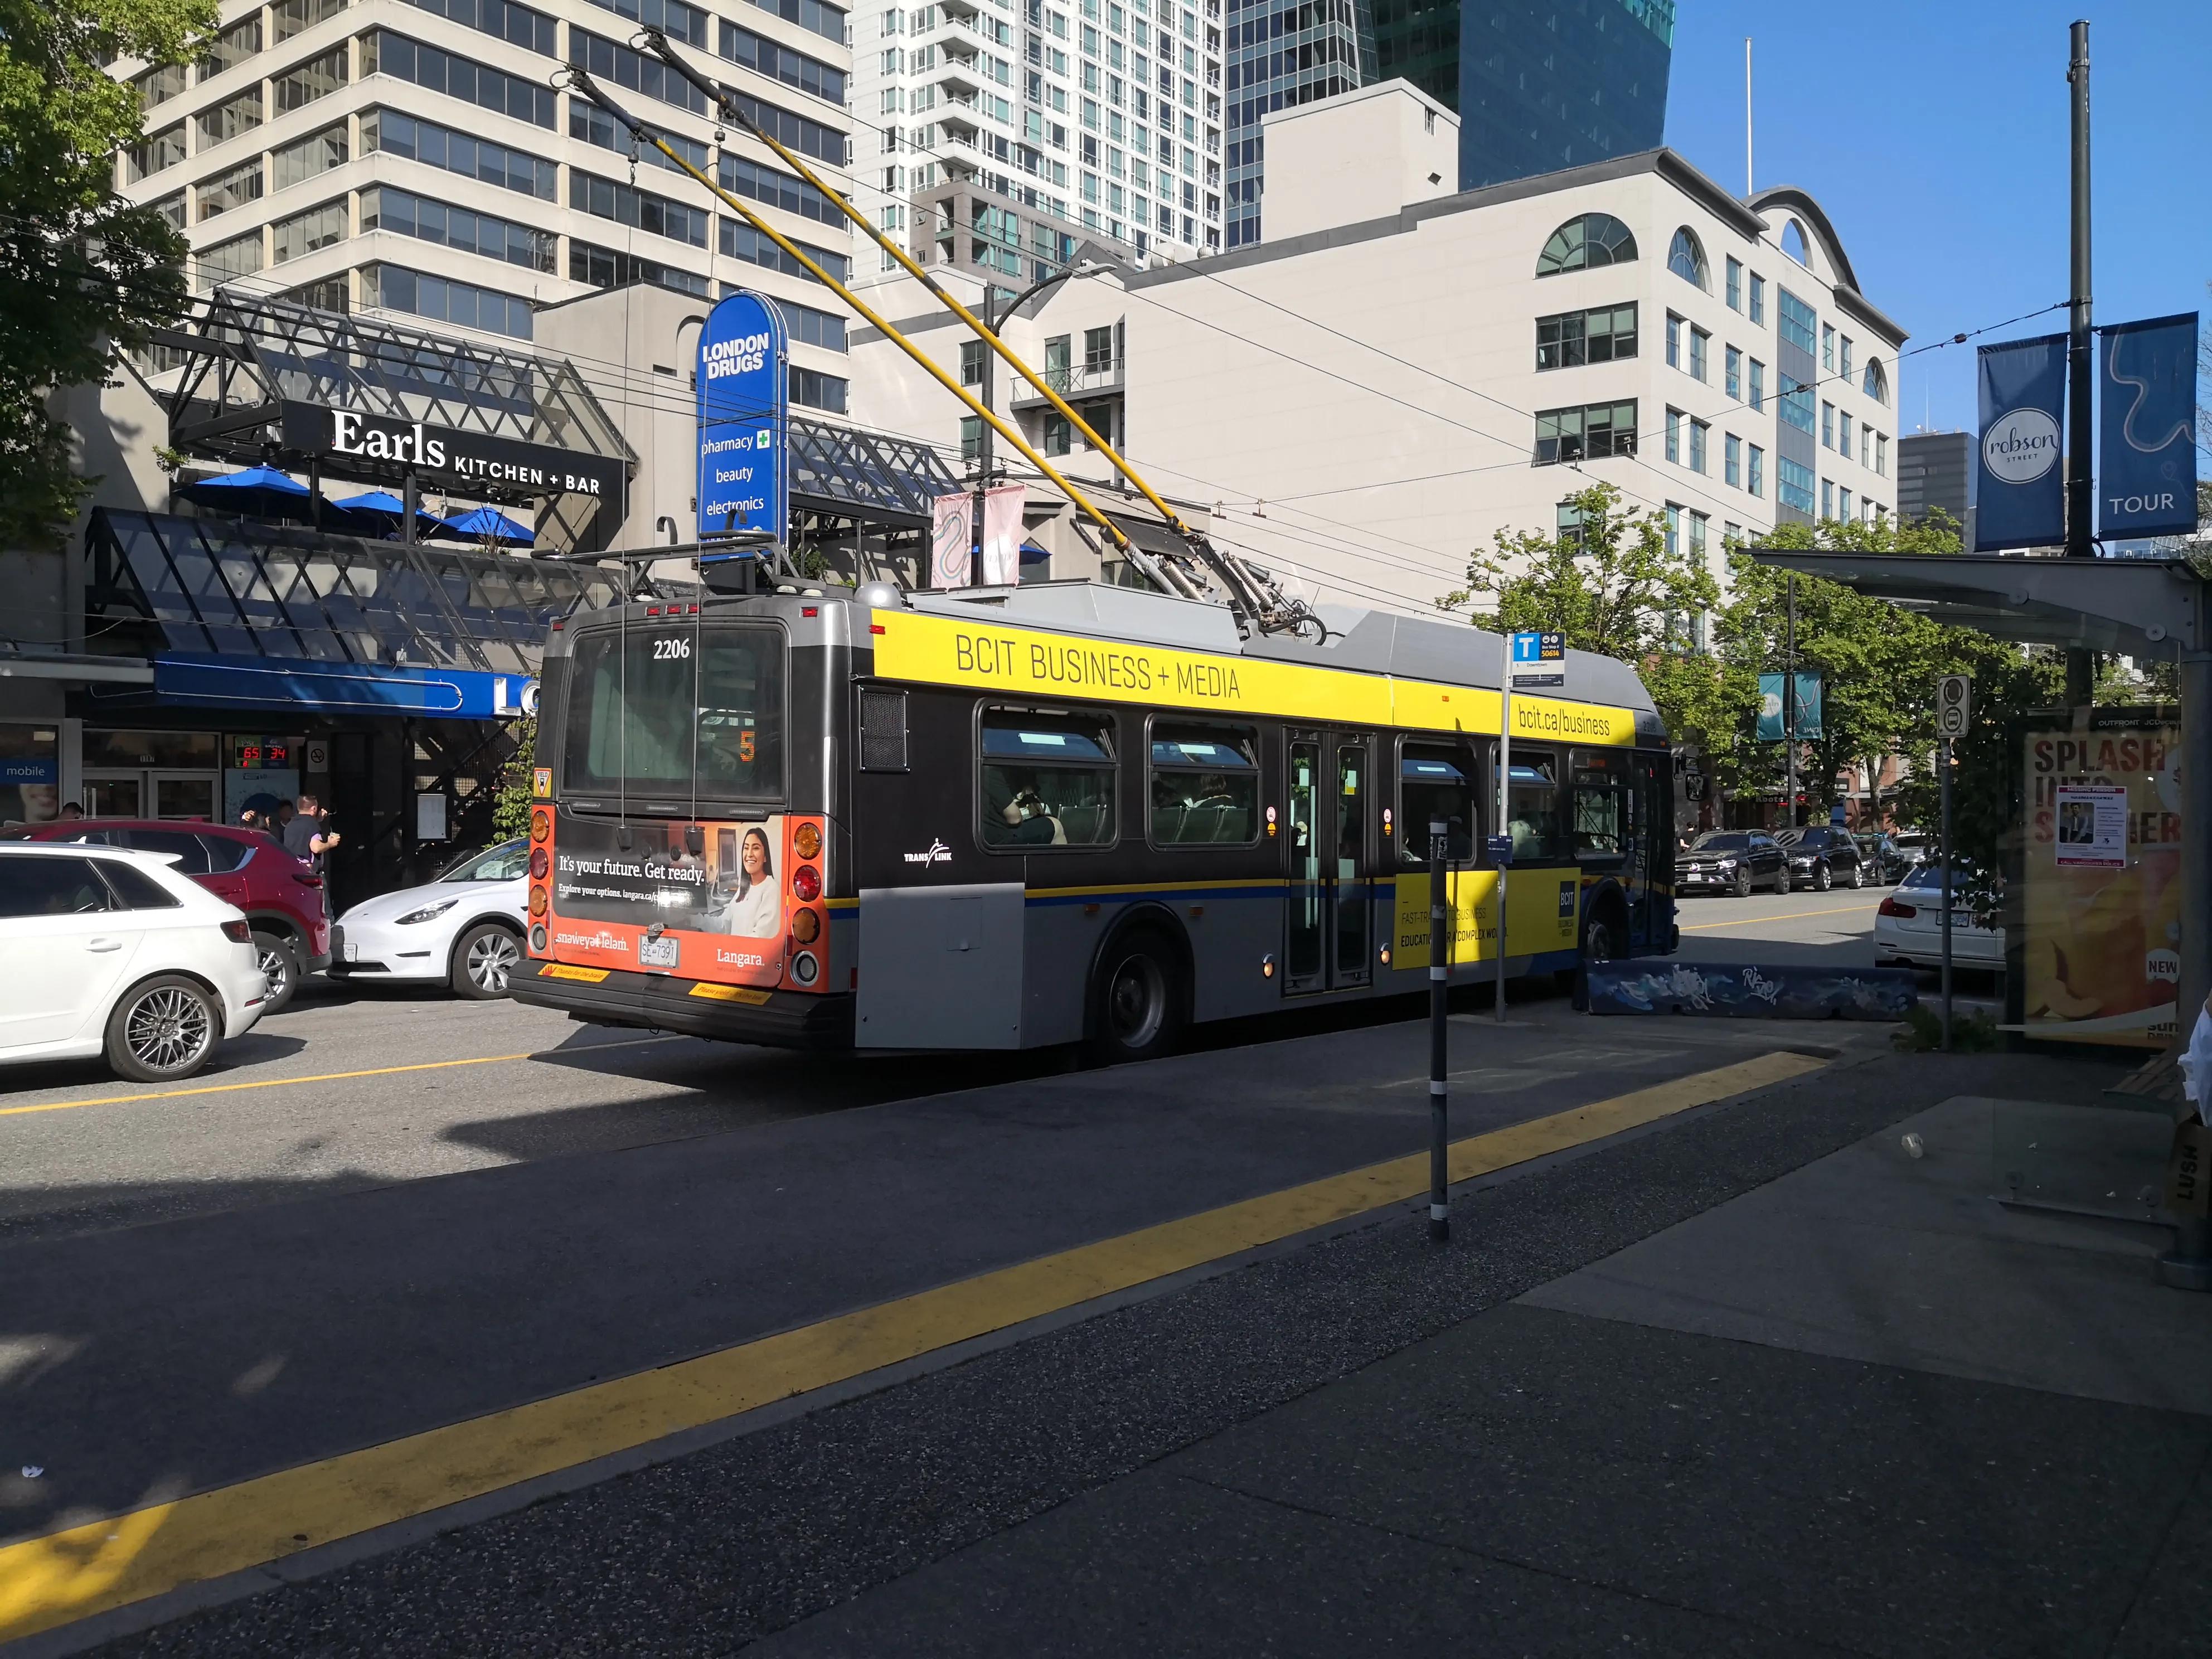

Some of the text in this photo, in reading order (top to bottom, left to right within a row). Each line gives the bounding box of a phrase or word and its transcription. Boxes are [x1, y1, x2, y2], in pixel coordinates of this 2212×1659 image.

[702, 332, 769, 362] LONDON
[708, 352, 764, 380] DRUGS
[331, 409, 445, 468] Earls
[701, 436, 753, 458] pharmacy
[1990, 427, 2059, 455] robson
[2006, 453, 2038, 463] STREET
[455, 456, 542, 485] KITCHEN
[565, 474, 600, 494] BAR
[716, 466, 754, 483] beauty
[706, 496, 764, 516] electronics
[2109, 493, 2174, 515] TOUR
[653, 638, 690, 659] 2206
[956, 634, 1016, 676] BCIT
[1031, 644, 1151, 691] BUSINESS
[1176, 662, 1240, 699] MEDIA
[1518, 703, 1611, 736] bcit.ca/business
[2098, 719, 2141, 727] OUTFRONT
[243, 746, 259, 759] 65
[270, 748, 285, 759] 34
[740, 731, 755, 762] 5
[2035, 739, 2165, 773] SPLASH
[6, 765, 45, 777] mobile
[559, 855, 705, 886] It's your future. Get ready.
[558, 883, 581, 894] Explore
[581, 886, 596, 896] your
[596, 887, 622, 898] options.
[1560, 892, 1574, 906] BCIT
[1456, 907, 1486, 920] BUSINESS
[1401, 933, 1431, 947] EDUCATI
[1457, 928, 1485, 942] COMPLEX
[716, 948, 765, 968] Langara.
[2148, 961, 2177, 973] NEW
[2177, 1145, 2198, 1200] LUSH
